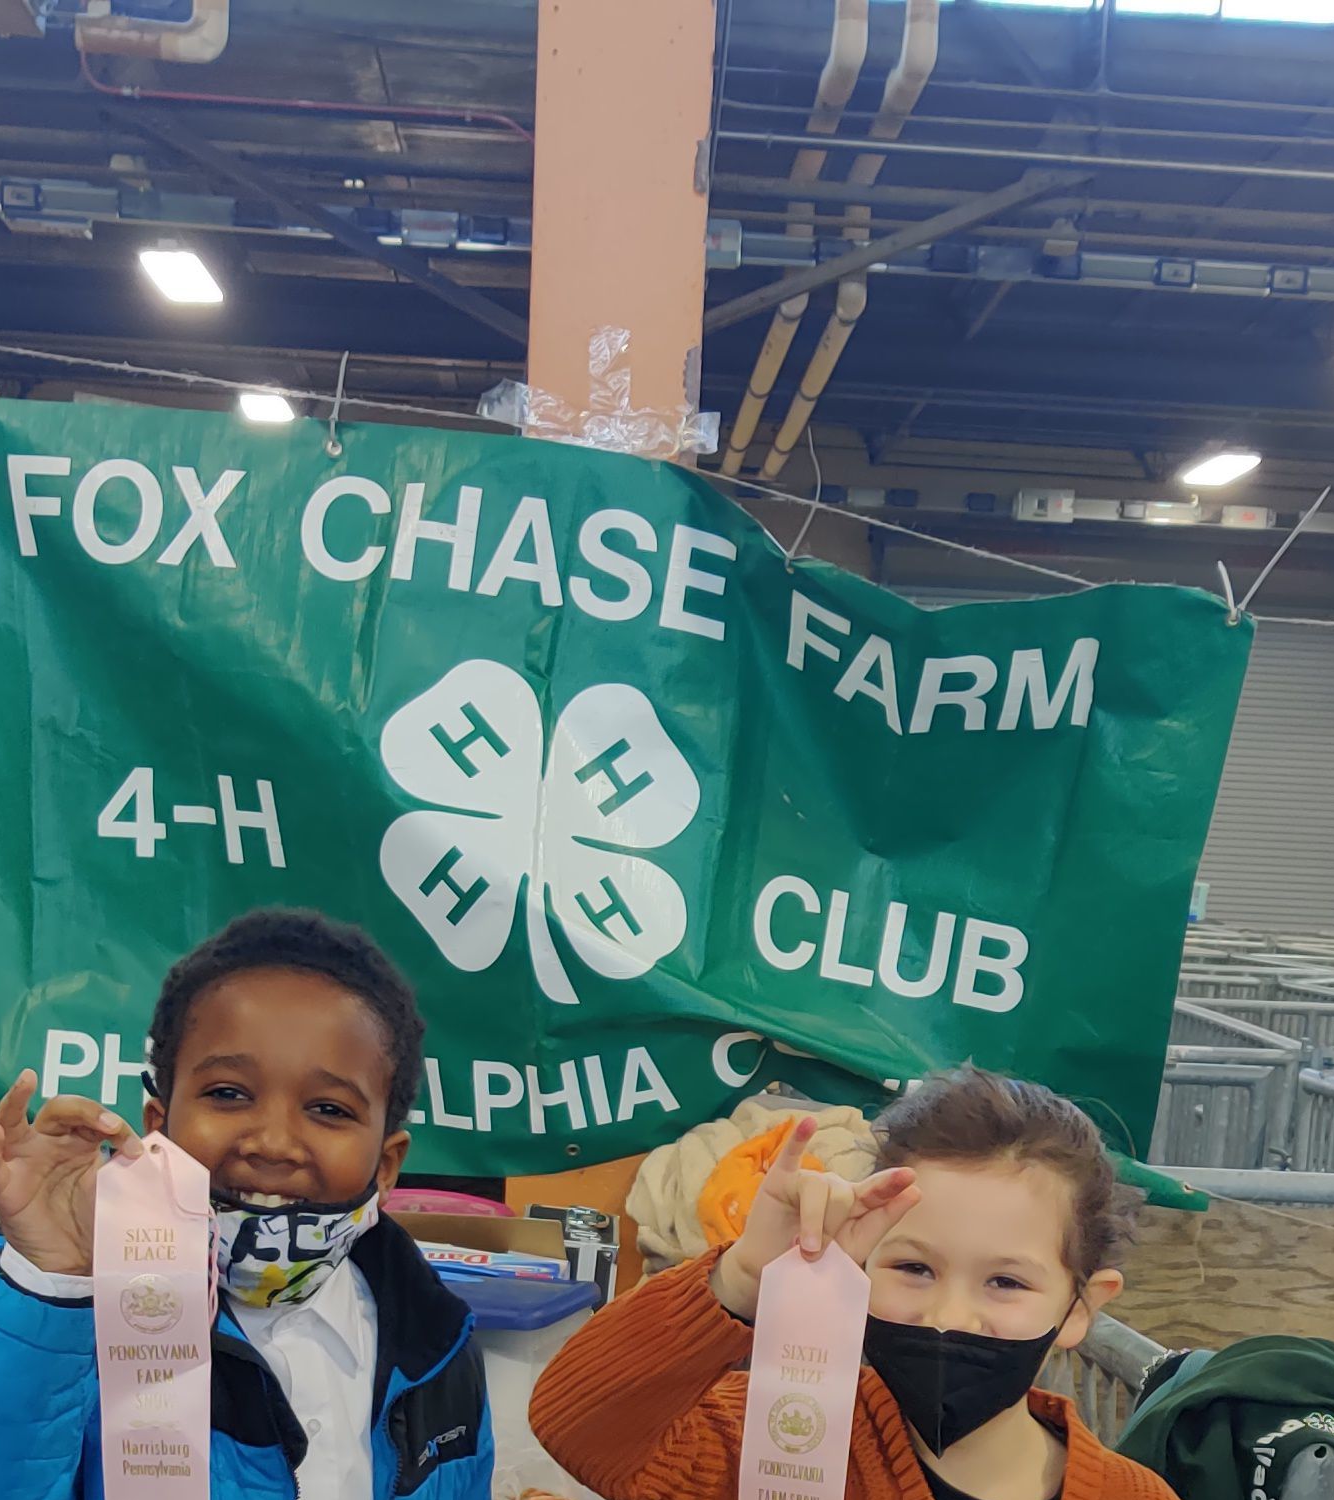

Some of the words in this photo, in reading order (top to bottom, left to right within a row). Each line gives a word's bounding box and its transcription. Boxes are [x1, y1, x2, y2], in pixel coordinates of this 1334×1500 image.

[7, 453, 244, 568] FOX
[301, 475, 739, 640] CHASE
[784, 590, 1100, 734] FARM
[429, 701, 512, 778] H
[574, 738, 655, 817] H
[97, 766, 286, 868] 4-H
[419, 845, 490, 926] H
[574, 876, 643, 944] H
[752, 873, 1030, 1013] CLUB
[125, 1228, 175, 1243] SIXTH
[124, 1245, 177, 1261] PLACE
[109, 1344, 199, 1361] PENNSYLVANIA
[781, 1344, 829, 1363] SIXTH
[137, 1368, 174, 1385] FARM
[780, 1366, 826, 1384] PRIZE
[122, 1440, 190, 1458] Harrisburg
[123, 1460, 191, 1478] Pennsylvania
[758, 1459, 824, 1483] PENNSYLVANIA
